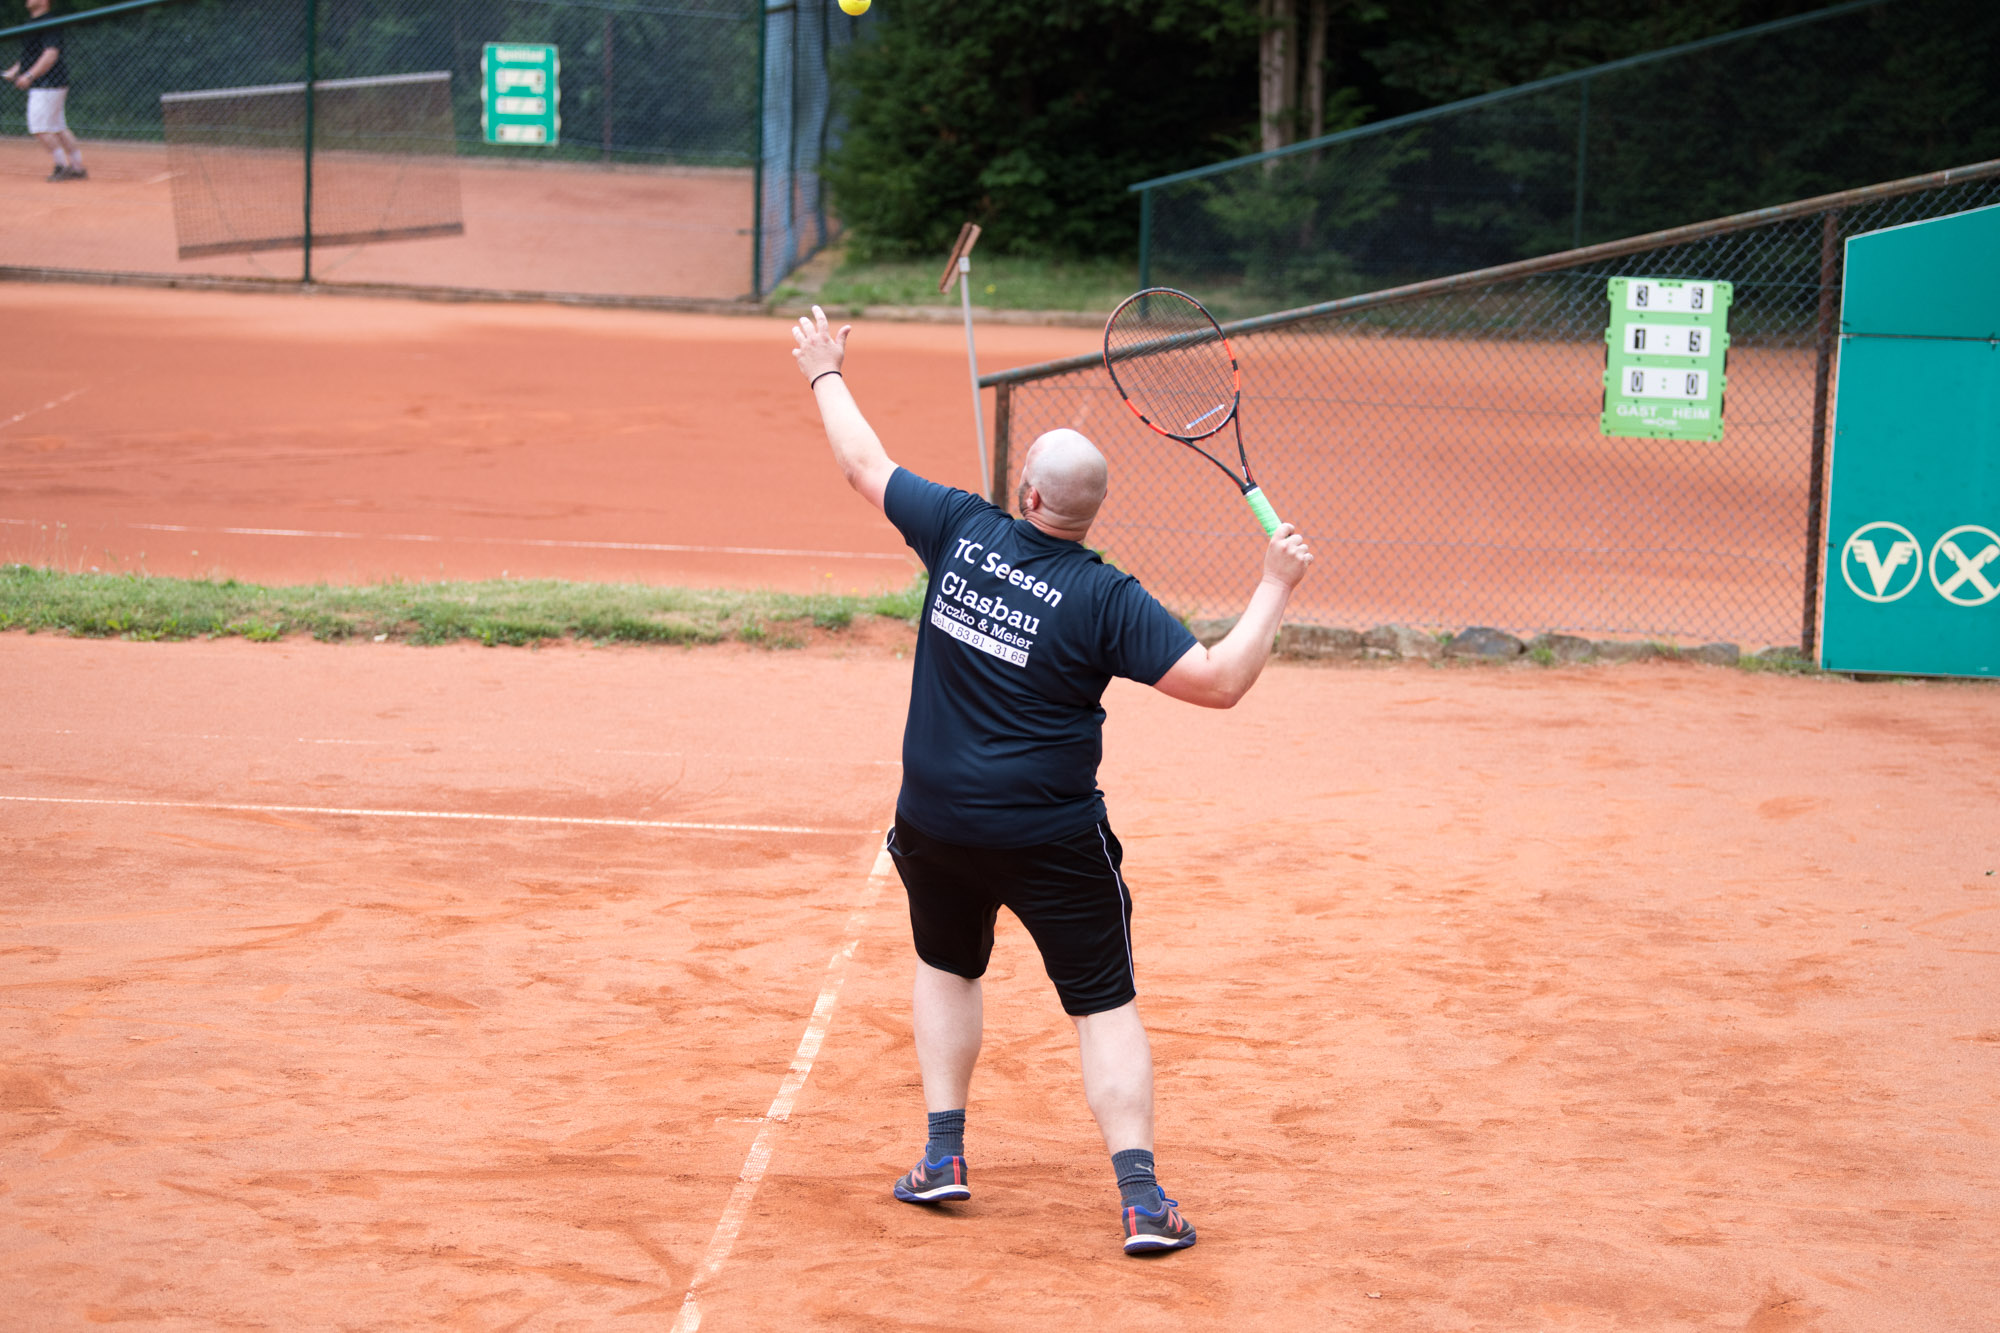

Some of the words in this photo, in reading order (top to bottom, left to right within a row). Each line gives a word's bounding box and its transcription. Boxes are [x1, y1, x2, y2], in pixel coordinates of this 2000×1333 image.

[1631, 370, 1643, 392] 0
[1686, 373, 1699, 395] 0
[1616, 404, 1658, 418] GAST
[1672, 406, 1710, 419] HEIM
[954, 538, 983, 564] TC
[981, 552, 1063, 608] Seesen
[934, 594, 976, 626] Ryczko
[977, 618, 989, 632] &
[990, 624, 1033, 650] Meier
[941, 571, 1040, 635] Glasbau
[955, 627, 970, 640] 53
[972, 635, 985, 647] 81
[994, 644, 1007, 658] 31
[1011, 651, 1026, 664] 65
